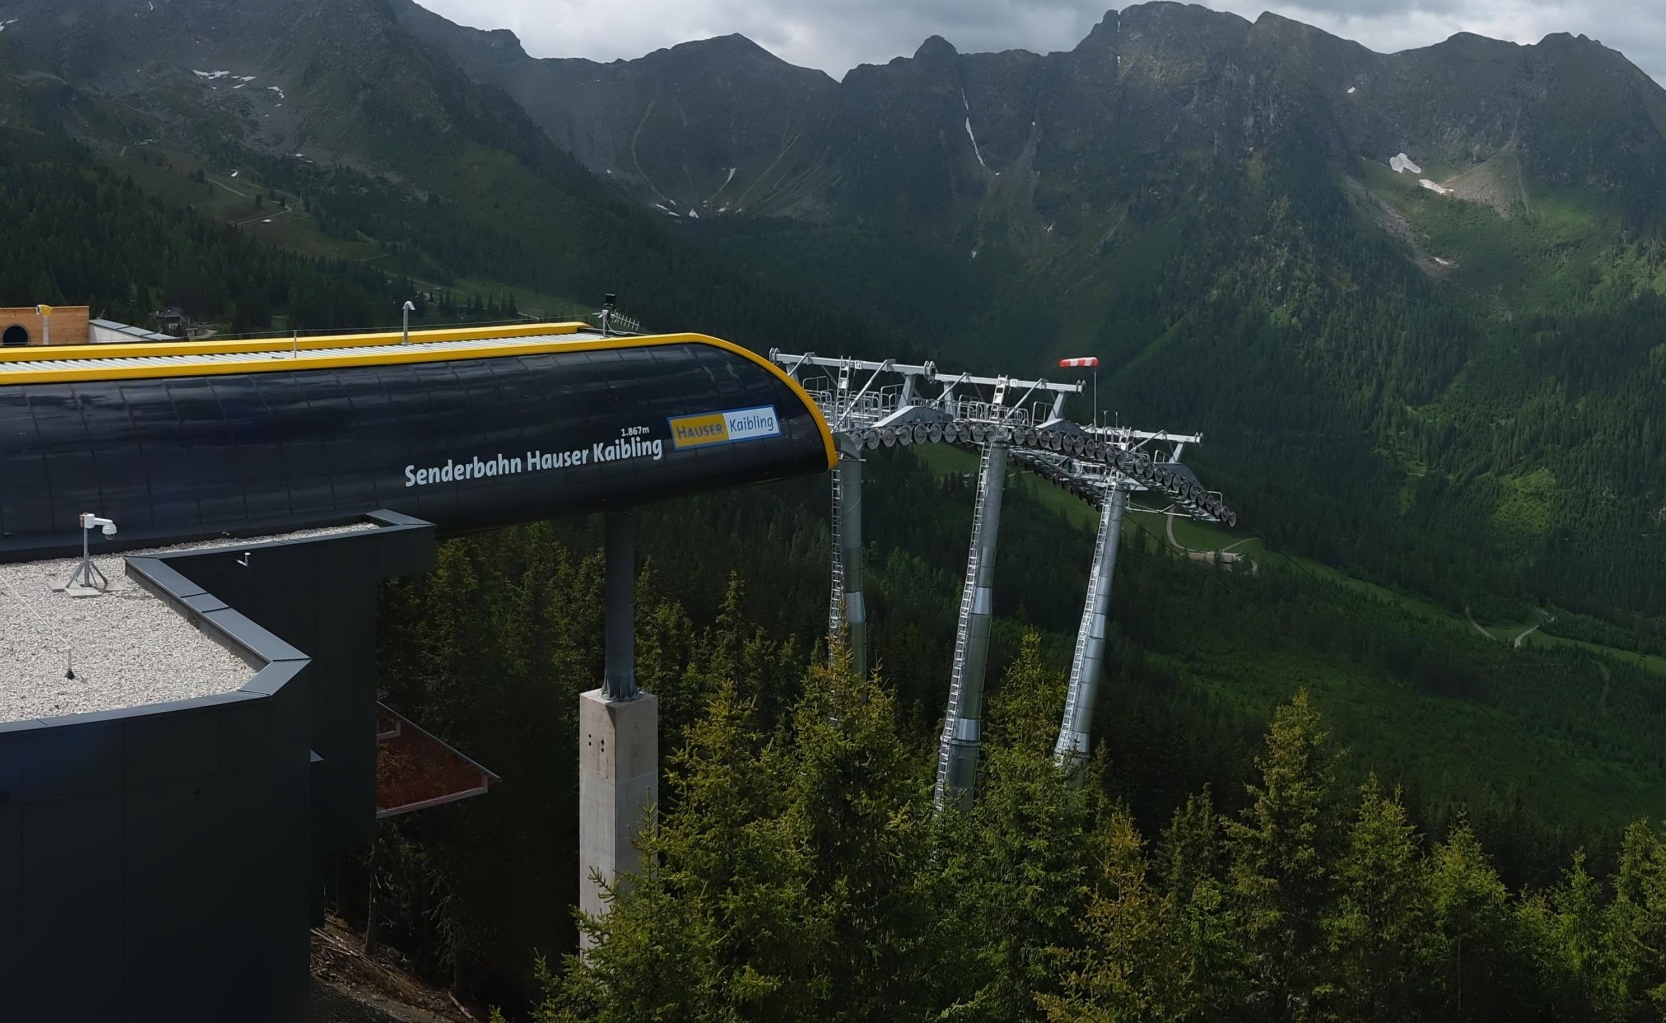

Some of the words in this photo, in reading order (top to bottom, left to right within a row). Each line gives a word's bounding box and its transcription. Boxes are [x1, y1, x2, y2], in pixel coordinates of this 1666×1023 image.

[620, 426, 650, 437] 1.867m
[676, 423, 723, 440] HAUSER
[729, 414, 774, 433] Kaibling
[404, 453, 522, 488] Senderbahn
[526, 449, 589, 472] Hauser
[593, 436, 663, 463] Kaibling
